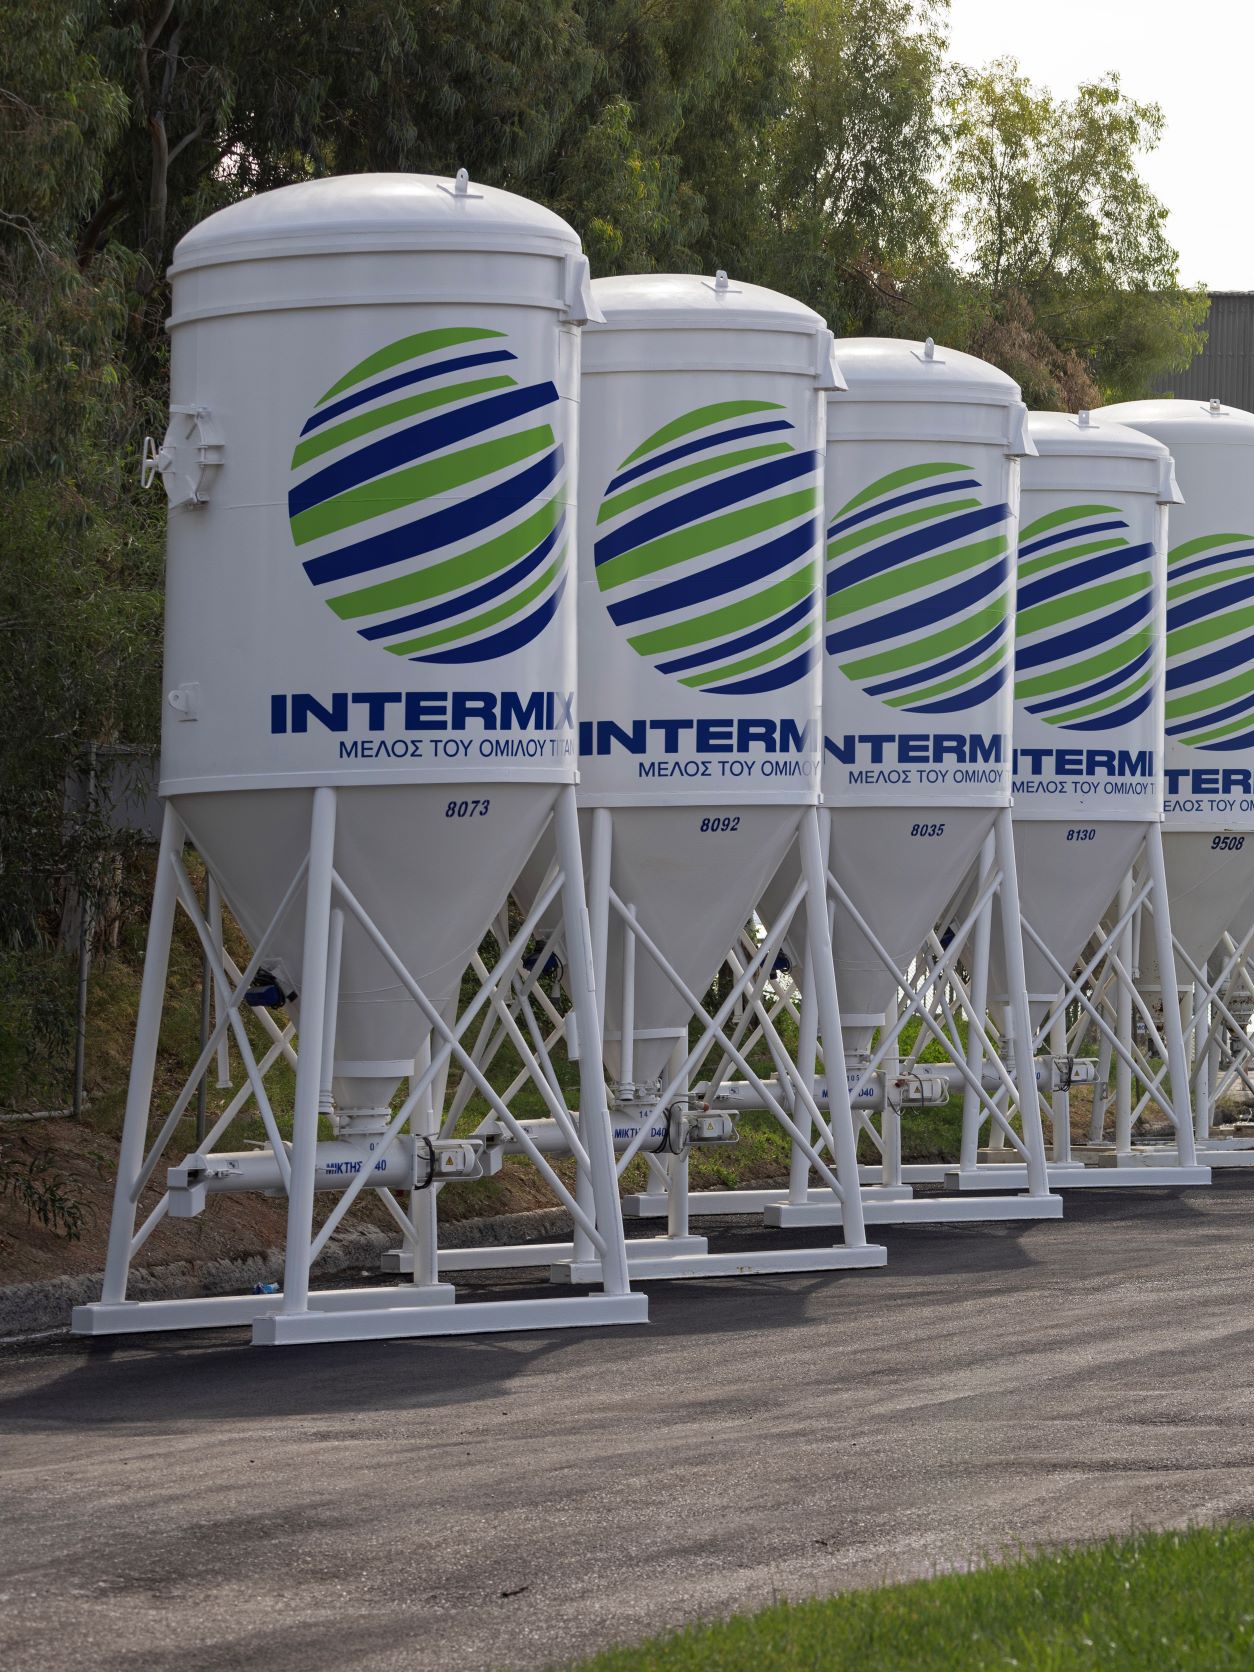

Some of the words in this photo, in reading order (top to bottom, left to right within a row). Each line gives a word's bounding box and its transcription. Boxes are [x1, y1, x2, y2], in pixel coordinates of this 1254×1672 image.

[271, 691, 574, 734] INTERMIX
[339, 740, 423, 759] ΜΕΛΟΣ
[430, 739, 473, 758] ΤΟΥ
[479, 738, 547, 758] ΟΜΙΛΟΥ
[638, 761, 713, 778] ΜΕΛΟΣ
[718, 761, 756, 777] ΤΟΥ
[849, 770, 912, 784] ΜΕΛΟΣ
[916, 769, 949, 784] ΤΟΥ
[953, 769, 1004, 784] ΟΜΙΛΟΥ
[1012, 781, 1067, 794] ΜΕΛΟΣ
[1072, 781, 1100, 794] ΤΟΥ
[1104, 781, 1148, 795] ΟΜΙΛΟΥ
[445, 799, 491, 818] 8073
[1208, 800, 1236, 812] ΤΟΥ
[700, 816, 741, 833] 8092
[910, 823, 946, 837] 8035
[1066, 828, 1096, 841] 8130
[1211, 836, 1245, 851] 9508
